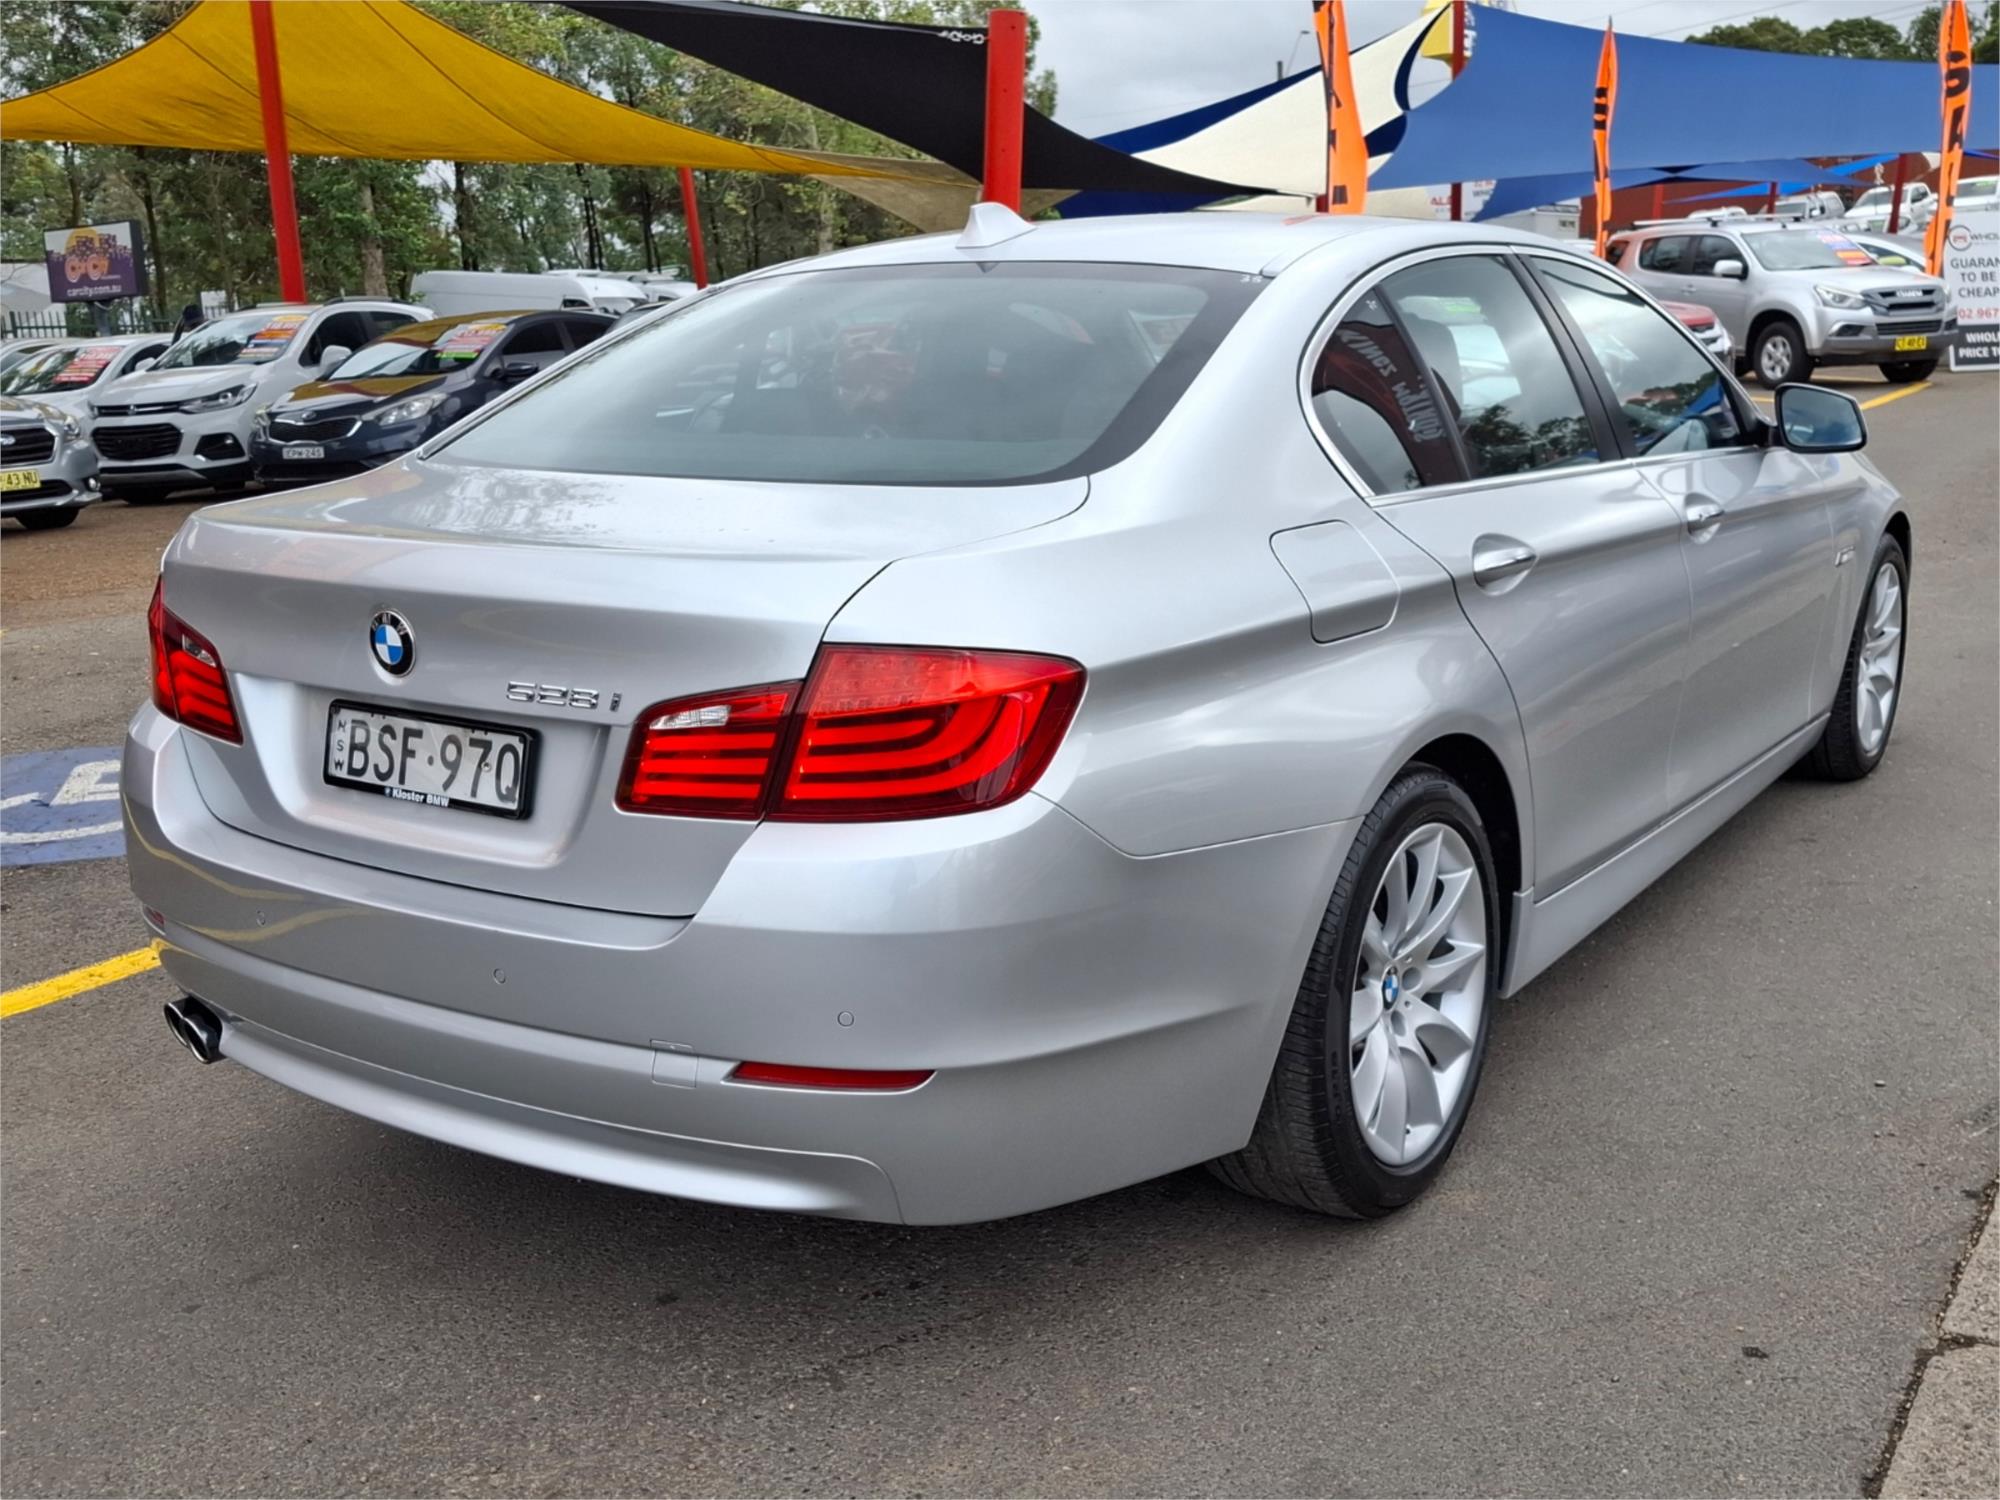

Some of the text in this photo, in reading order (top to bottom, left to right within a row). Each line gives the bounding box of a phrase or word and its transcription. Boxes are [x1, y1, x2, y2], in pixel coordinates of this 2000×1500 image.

[1961, 271, 1996, 282] TO BE
[1965, 331, 2000, 343] WHOL
[1959, 346, 1989, 359] PRICE
[6, 471, 38, 486] 43 NU
[391, 787, 450, 808] Kloster BMW
